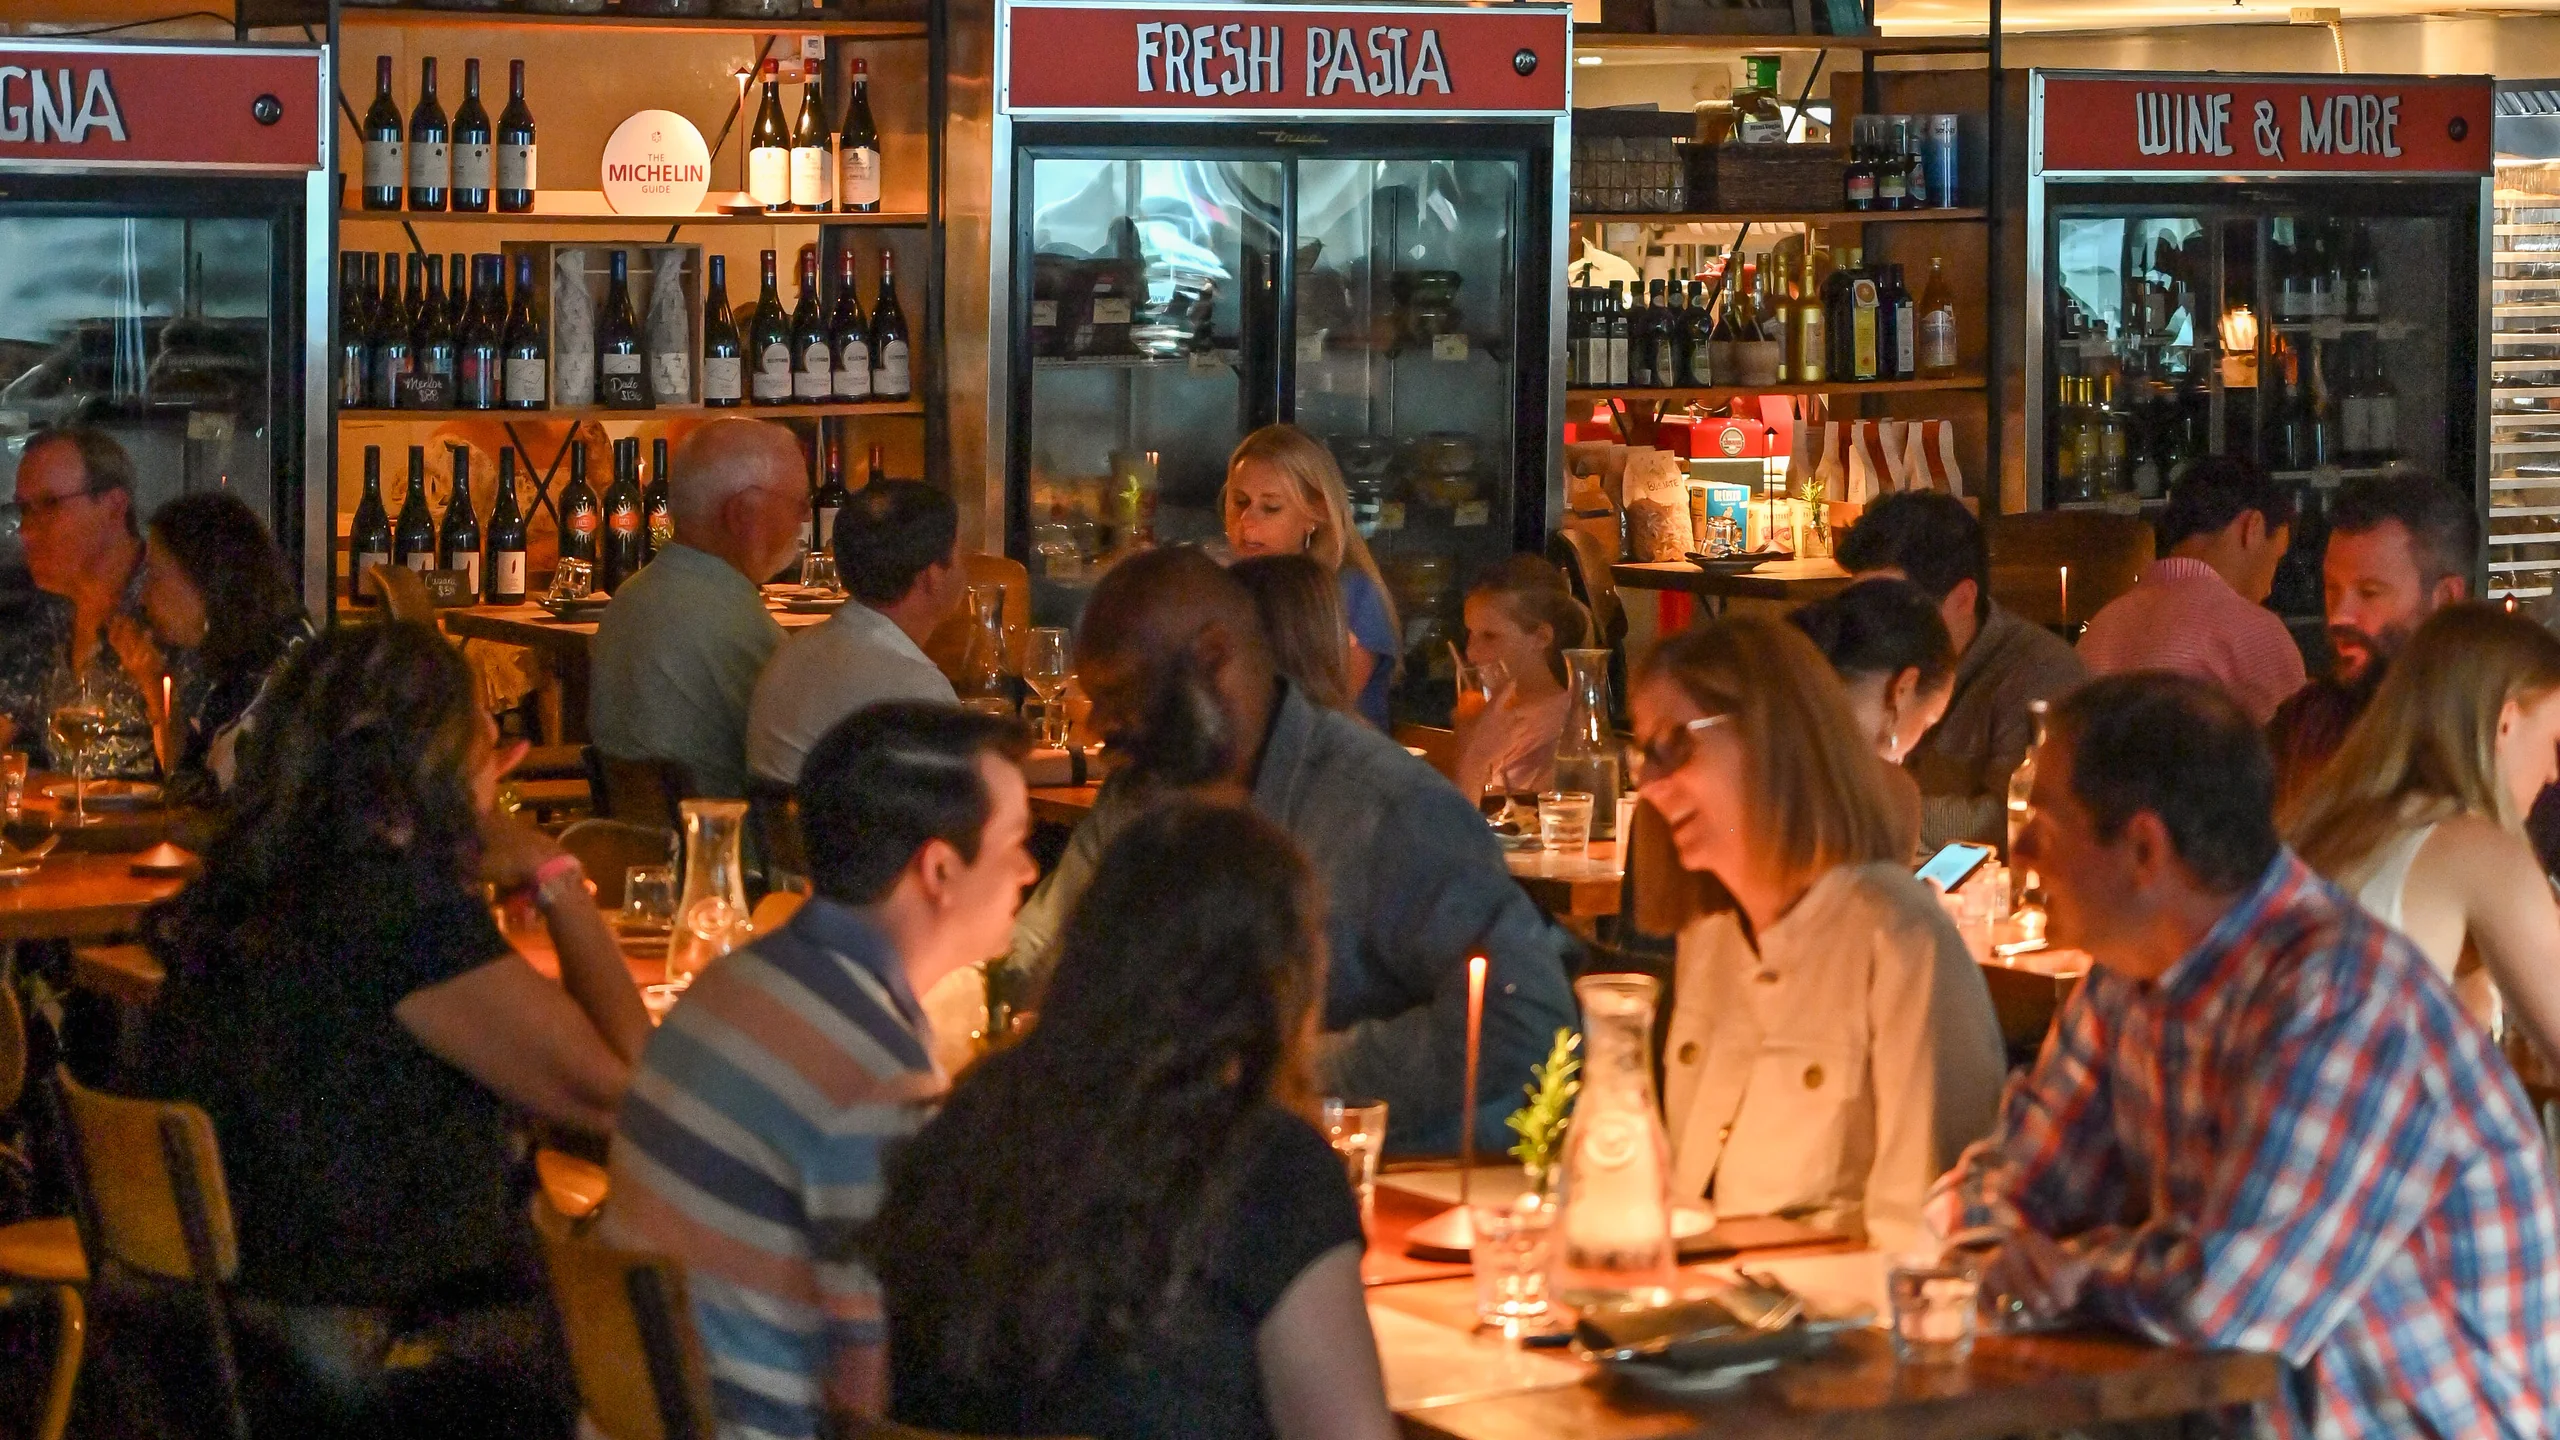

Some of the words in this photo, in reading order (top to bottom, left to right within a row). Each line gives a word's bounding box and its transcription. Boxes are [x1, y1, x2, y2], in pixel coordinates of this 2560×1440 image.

[1137, 22, 1281, 97] FRESH
[1306, 26, 1451, 97] PASTA
[2136, 92, 2234, 157] WINE
[2253, 99, 2284, 163] &
[2300, 94, 2402, 158] MORE
[647, 153, 665, 162] THE
[609, 164, 703, 182] MICHELIN
[641, 185, 671, 194] GUIDE
